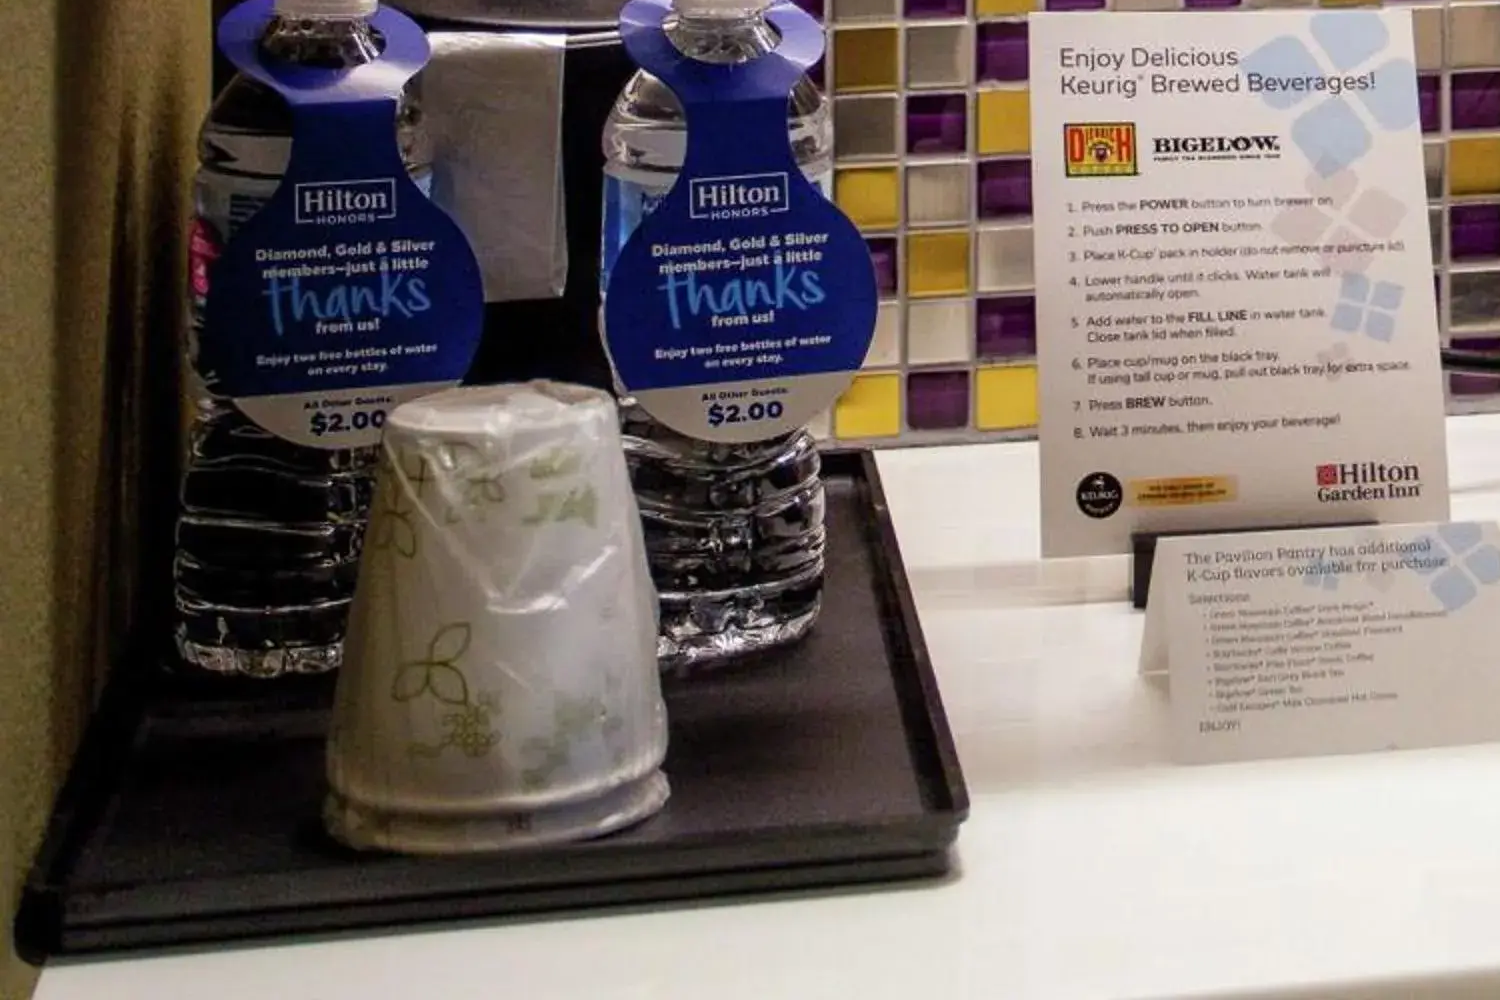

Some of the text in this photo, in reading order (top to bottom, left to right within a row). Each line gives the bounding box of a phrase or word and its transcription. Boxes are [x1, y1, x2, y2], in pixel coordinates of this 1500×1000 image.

[1060, 47, 1239, 71] Enjoy Delicious
[1151, 74, 1240, 94] Brewed
[1248, 71, 1376, 96] Beverages!
[304, 190, 387, 212] Hilton
[699, 184, 780, 208] Hilton
[1081, 197, 1314, 213] Press the POWER button to turn brewer
[316, 213, 375, 225] HONORS
[711, 208, 769, 220] HONORS
[1083, 223, 1219, 236] Push PRESS TO OPEN
[255, 239, 435, 261] Diamond, Gold & Silver
[652, 232, 828, 257] Diamond, Gold & Silver
[1084, 250, 1114, 261] Place
[1159, 248, 1186, 260] pack
[1187, 248, 1199, 257] in
[1201, 245, 1238, 257] holder
[1260, 246, 1279, 255] not
[1280, 245, 1319, 254] remove
[1322, 244, 1334, 252] or
[1337, 242, 1384, 253] puncture
[380, 260, 388, 268] a
[392, 257, 428, 269] little
[773, 255, 782, 263] a
[786, 250, 822, 263] little
[1085, 276, 1121, 286] Lower
[1124, 274, 1164, 285] handle
[1168, 271, 1194, 282] until
[1246, 270, 1280, 279] Water
[1283, 269, 1309, 278] tank
[1312, 267, 1331, 277] will
[1085, 290, 1164, 301] automatically
[316, 319, 380, 334] from us!
[711, 311, 774, 327] from us!
[1086, 316, 1112, 327] Add
[1116, 316, 1149, 325] water
[1151, 315, 1162, 324] to
[1165, 314, 1185, 324] the
[1188, 311, 1214, 323] FILL
[1217, 310, 1248, 322] LINE
[1250, 311, 1260, 320] in
[1265, 310, 1296, 319] water
[1088, 332, 1120, 342] Close
[1124, 330, 1149, 341] tank
[1152, 330, 1166, 339] lid
[1170, 328, 1203, 338] when
[256, 342, 438, 366] Enjoy two free bottles of water
[655, 335, 831, 359] Enjoy two free bottles of water
[704, 359, 719, 368] on
[722, 356, 753, 367] every
[1087, 358, 1121, 368] Place
[1123, 355, 1178, 367] cup/mug
[1181, 355, 1197, 365] on
[1200, 352, 1219, 363] the
[1222, 351, 1253, 363] black
[308, 366, 323, 376] on
[325, 364, 357, 374] every
[1087, 374, 1097, 384] If
[1098, 374, 1130, 385] using
[1133, 372, 1150, 382] tall
[1154, 373, 1175, 382] cup
[1224, 367, 1245, 378] pull
[1248, 366, 1267, 376] out
[1270, 364, 1300, 375] black
[1303, 363, 1325, 375] tray
[1327, 362, 1343, 373] for
[1345, 362, 1373, 372] extra
[707, 401, 783, 426] $2.00
[1089, 400, 1122, 411] Press
[1126, 397, 1166, 409] BREW
[310, 409, 388, 436] $2.00
[1089, 425, 1118, 437] Wait
[1187, 421, 1215, 432] then
[1217, 420, 1249, 432] enjoy
[1252, 419, 1278, 430] your
[1282, 412, 1341, 427] beverage!
[1339, 462, 1419, 484] Hilton
[1317, 484, 1421, 503] Garden Inn
[1184, 538, 1431, 565] The Pavilion Pantry has additional
[1187, 556, 1446, 583] K-Cup flavors available for purchase
